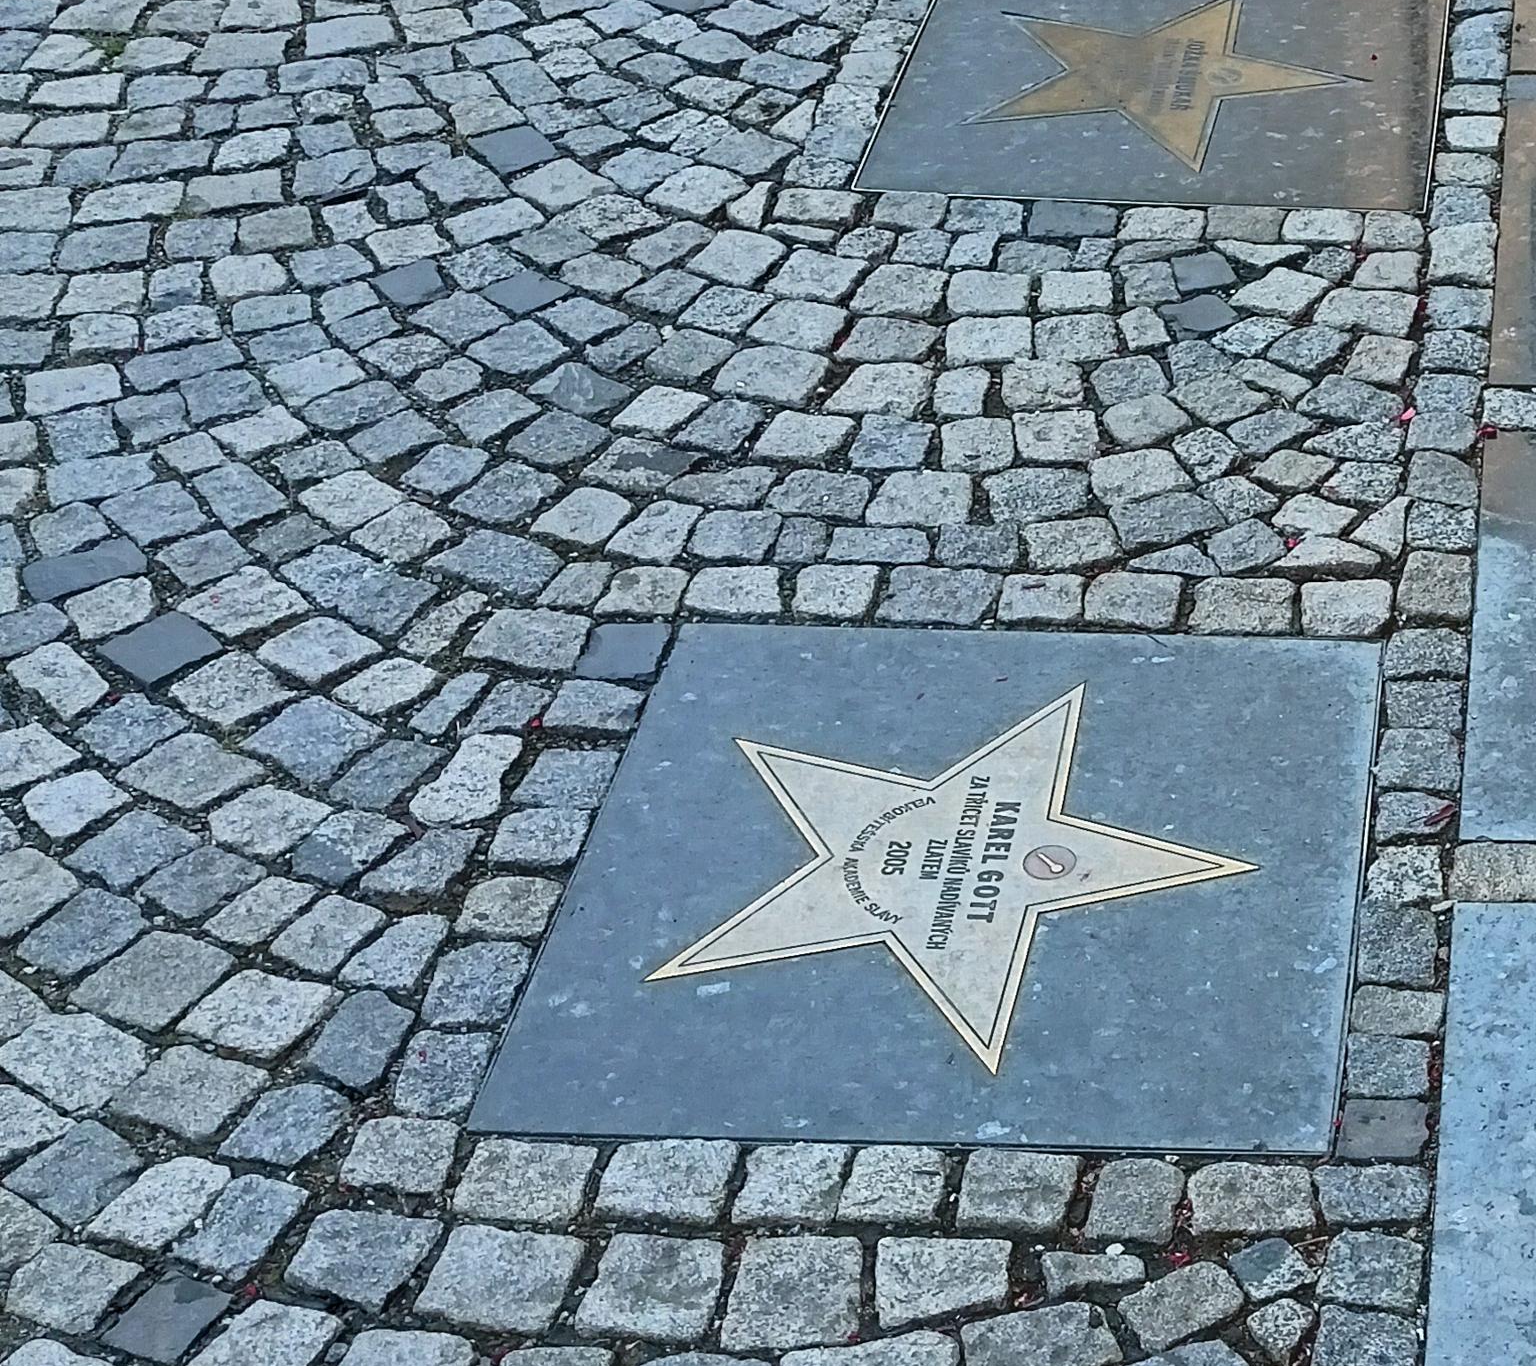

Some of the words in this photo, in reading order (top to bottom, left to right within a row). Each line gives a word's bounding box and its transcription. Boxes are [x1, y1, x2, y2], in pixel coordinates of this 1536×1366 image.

[969, 775, 991, 790] ZA
[959, 791, 988, 827] TŘICET
[946, 829, 976, 875] SLAVÍKŮ
[981, 802, 1022, 864] KAREL
[843, 857, 870, 905] AKADEMIE
[881, 840, 912, 876] 2005
[919, 838, 948, 880] ZLATEM
[925, 878, 964, 950] NADÍVANÝCH
[967, 870, 1004, 924] GOTT
